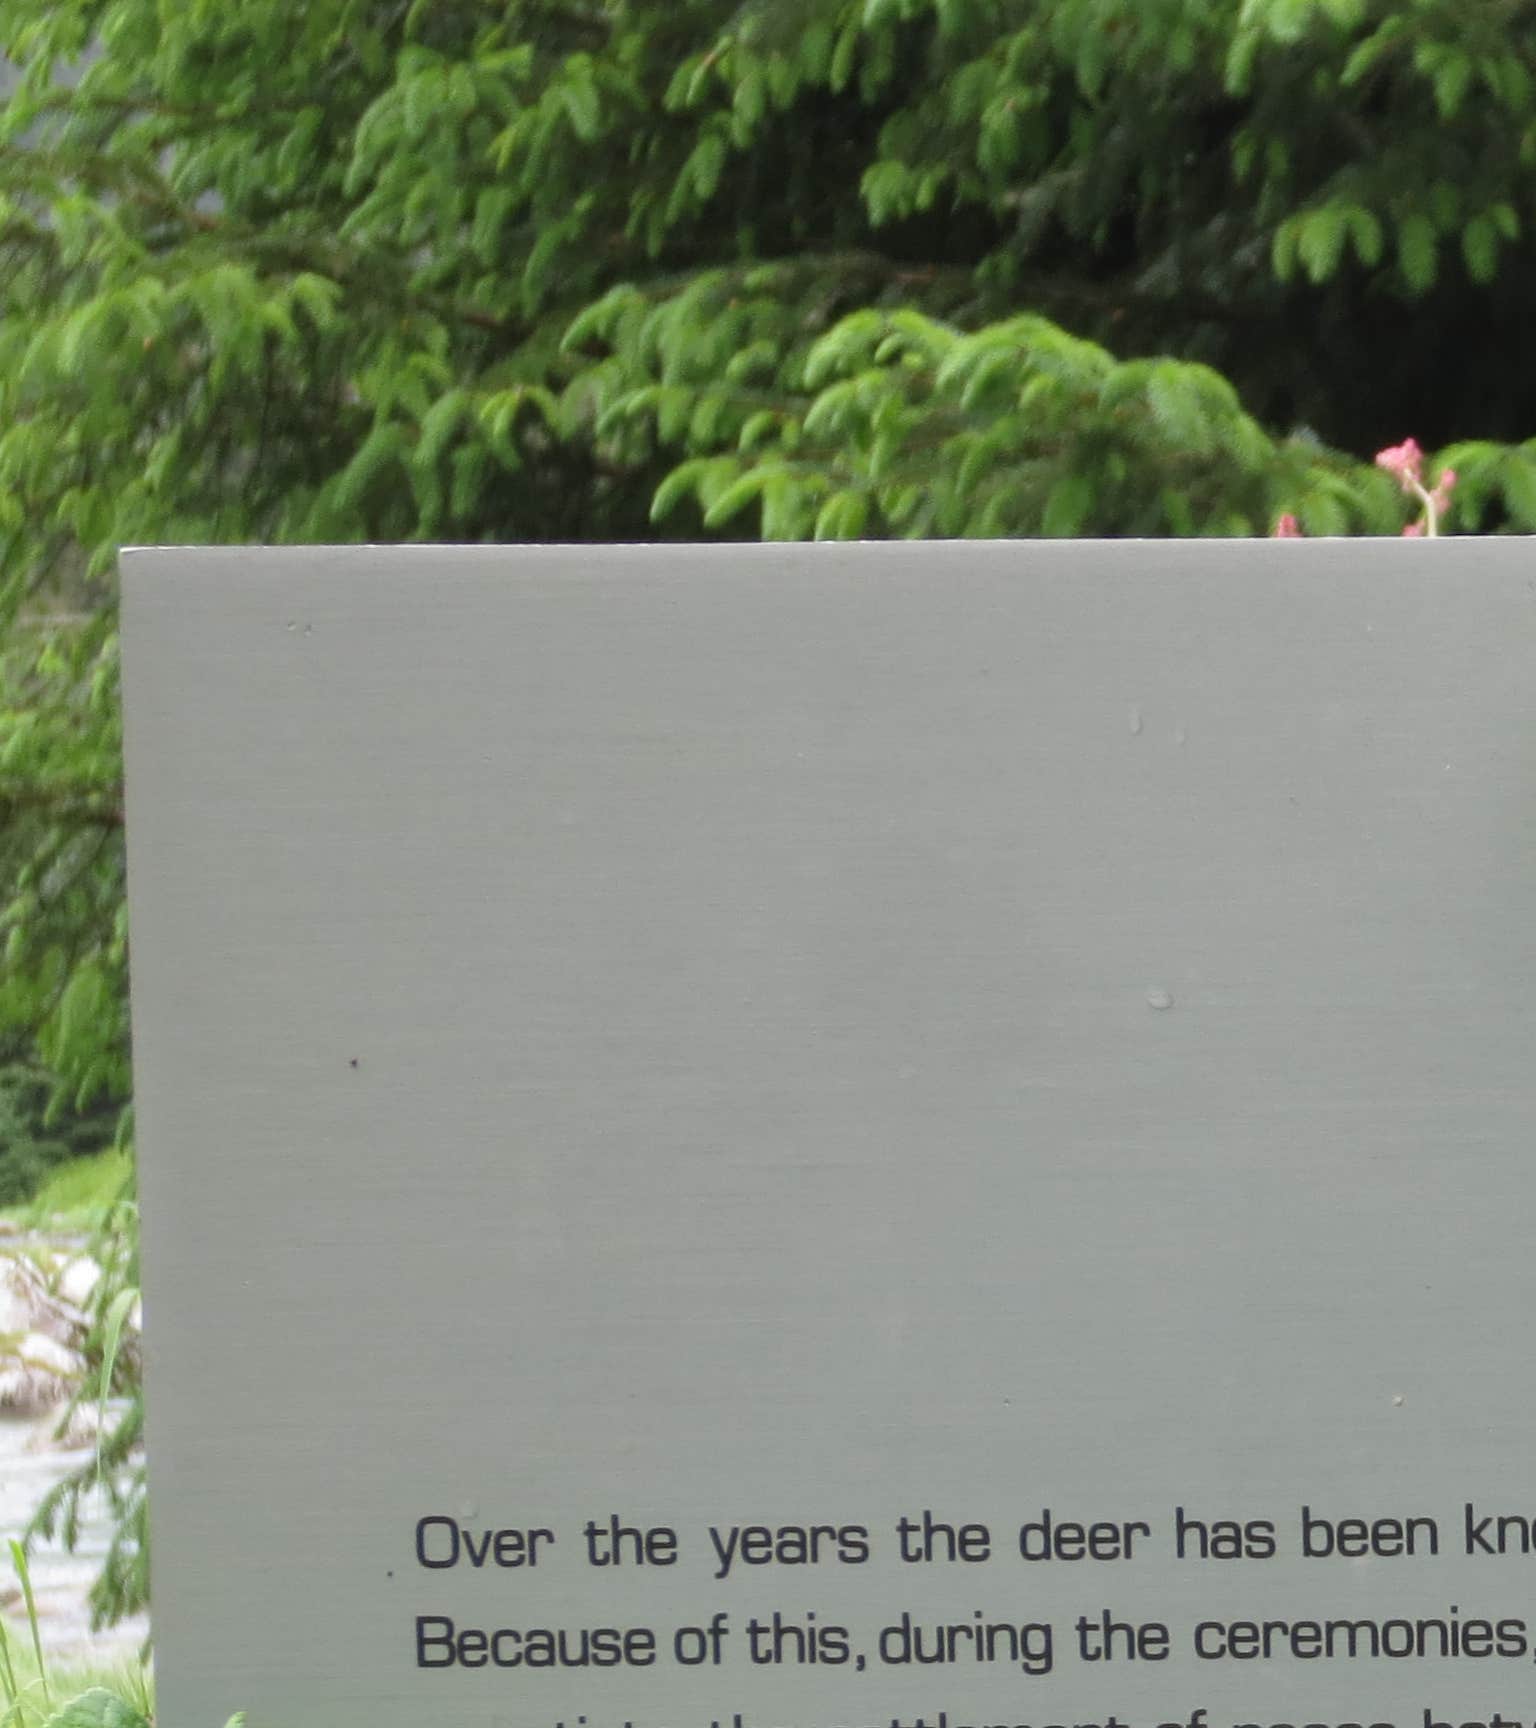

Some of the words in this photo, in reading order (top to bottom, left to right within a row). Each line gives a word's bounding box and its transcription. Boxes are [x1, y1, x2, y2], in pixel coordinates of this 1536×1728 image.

[415, 1515, 556, 1570] Over
[582, 1513, 678, 1567] the
[708, 1525, 870, 1580] years
[895, 1509, 991, 1564] the
[1018, 1508, 1151, 1562] deer
[1175, 1506, 1277, 1560] has
[1301, 1505, 1439, 1558] been
[415, 1615, 657, 1669] Because
[673, 1612, 730, 1666] of
[745, 1611, 867, 1672] this,
[878, 1610, 1054, 1676] during
[1074, 1608, 1170, 1662] the
